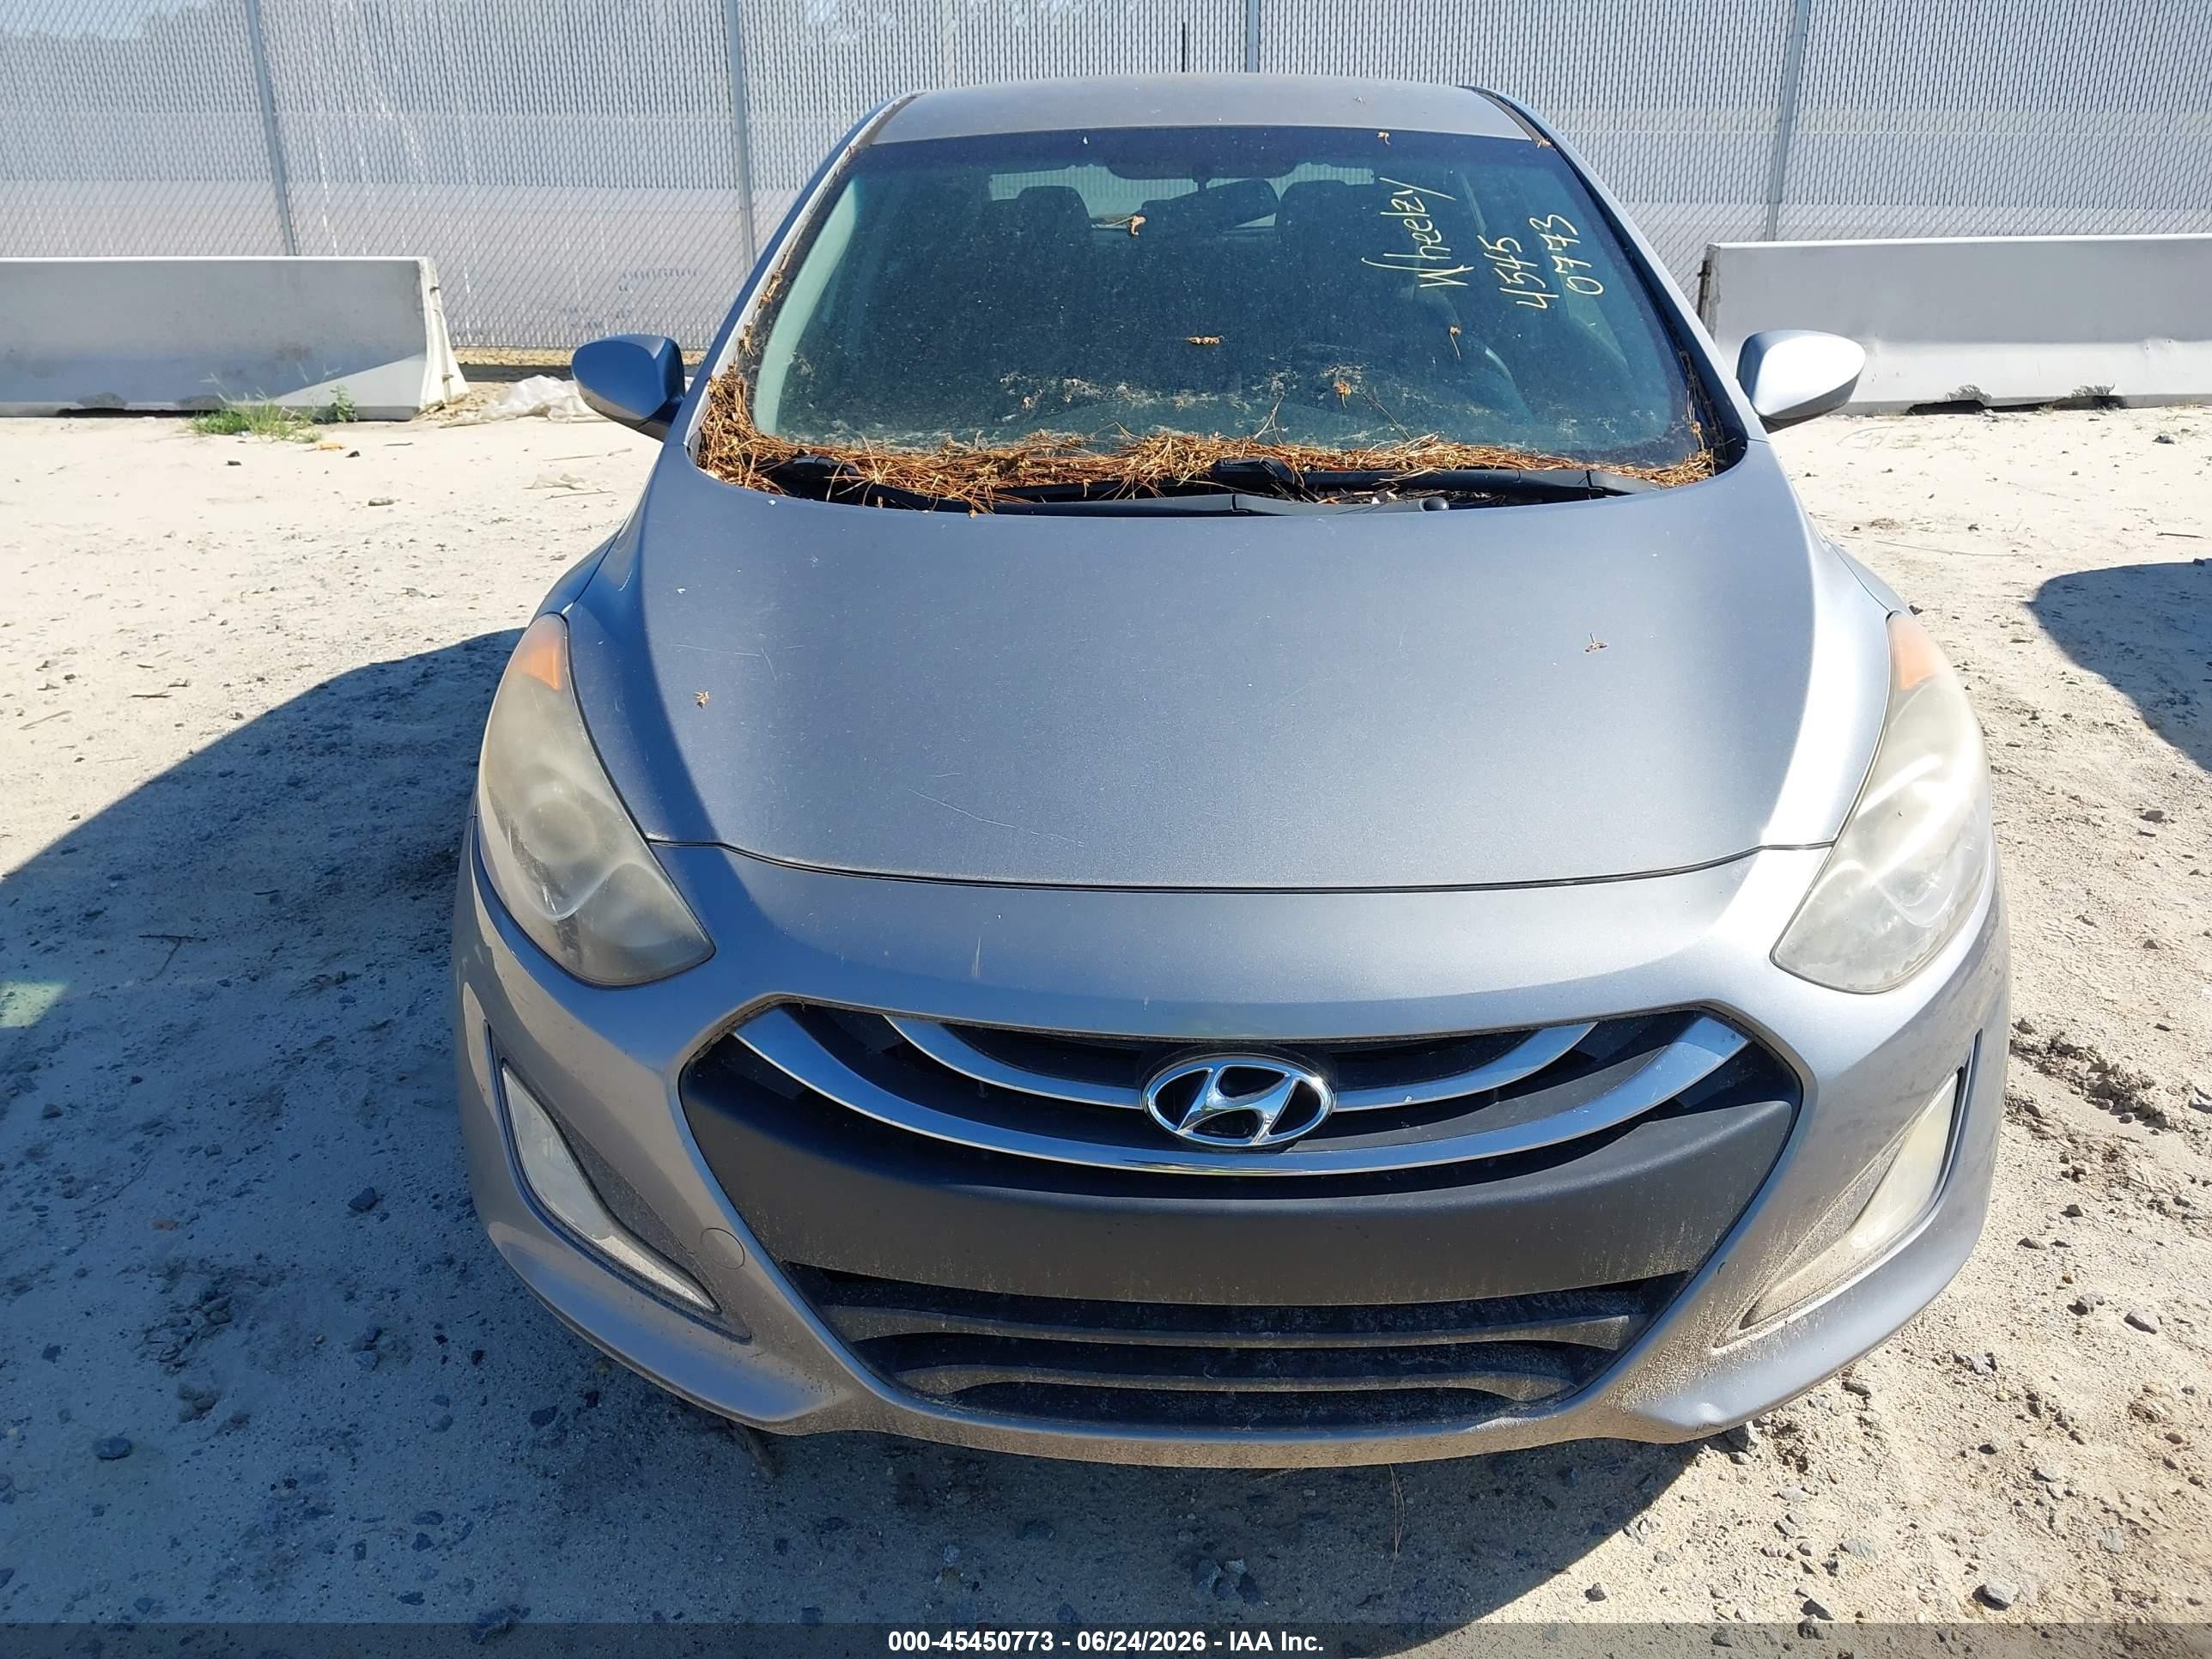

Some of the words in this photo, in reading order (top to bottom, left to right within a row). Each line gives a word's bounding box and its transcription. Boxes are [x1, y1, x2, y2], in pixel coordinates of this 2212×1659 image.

[1361, 177, 1475, 289] Wheelzy
[1477, 234, 1560, 310] 4545
[1528, 214, 1605, 296] 0773
